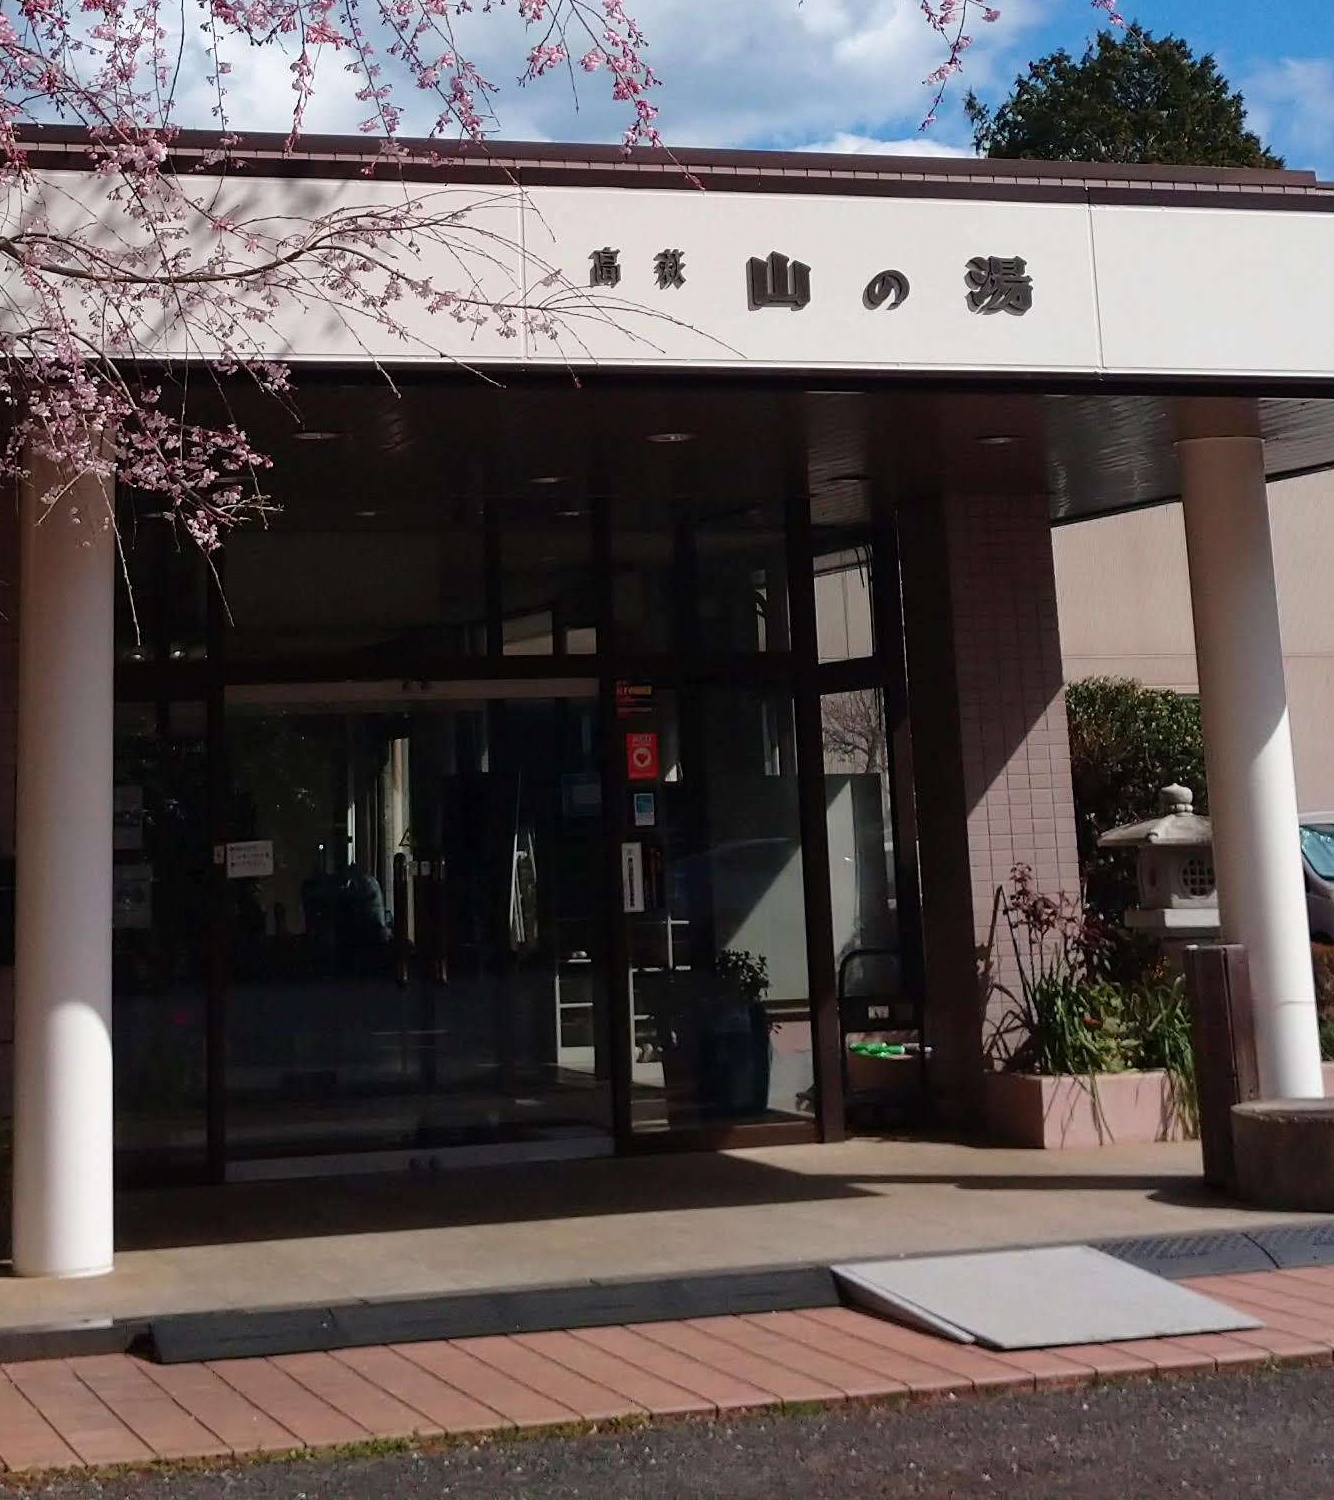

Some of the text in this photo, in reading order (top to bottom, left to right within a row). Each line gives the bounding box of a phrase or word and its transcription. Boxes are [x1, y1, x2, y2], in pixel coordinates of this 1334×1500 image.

[588, 246, 1034, 317] 高萩 山の湯
